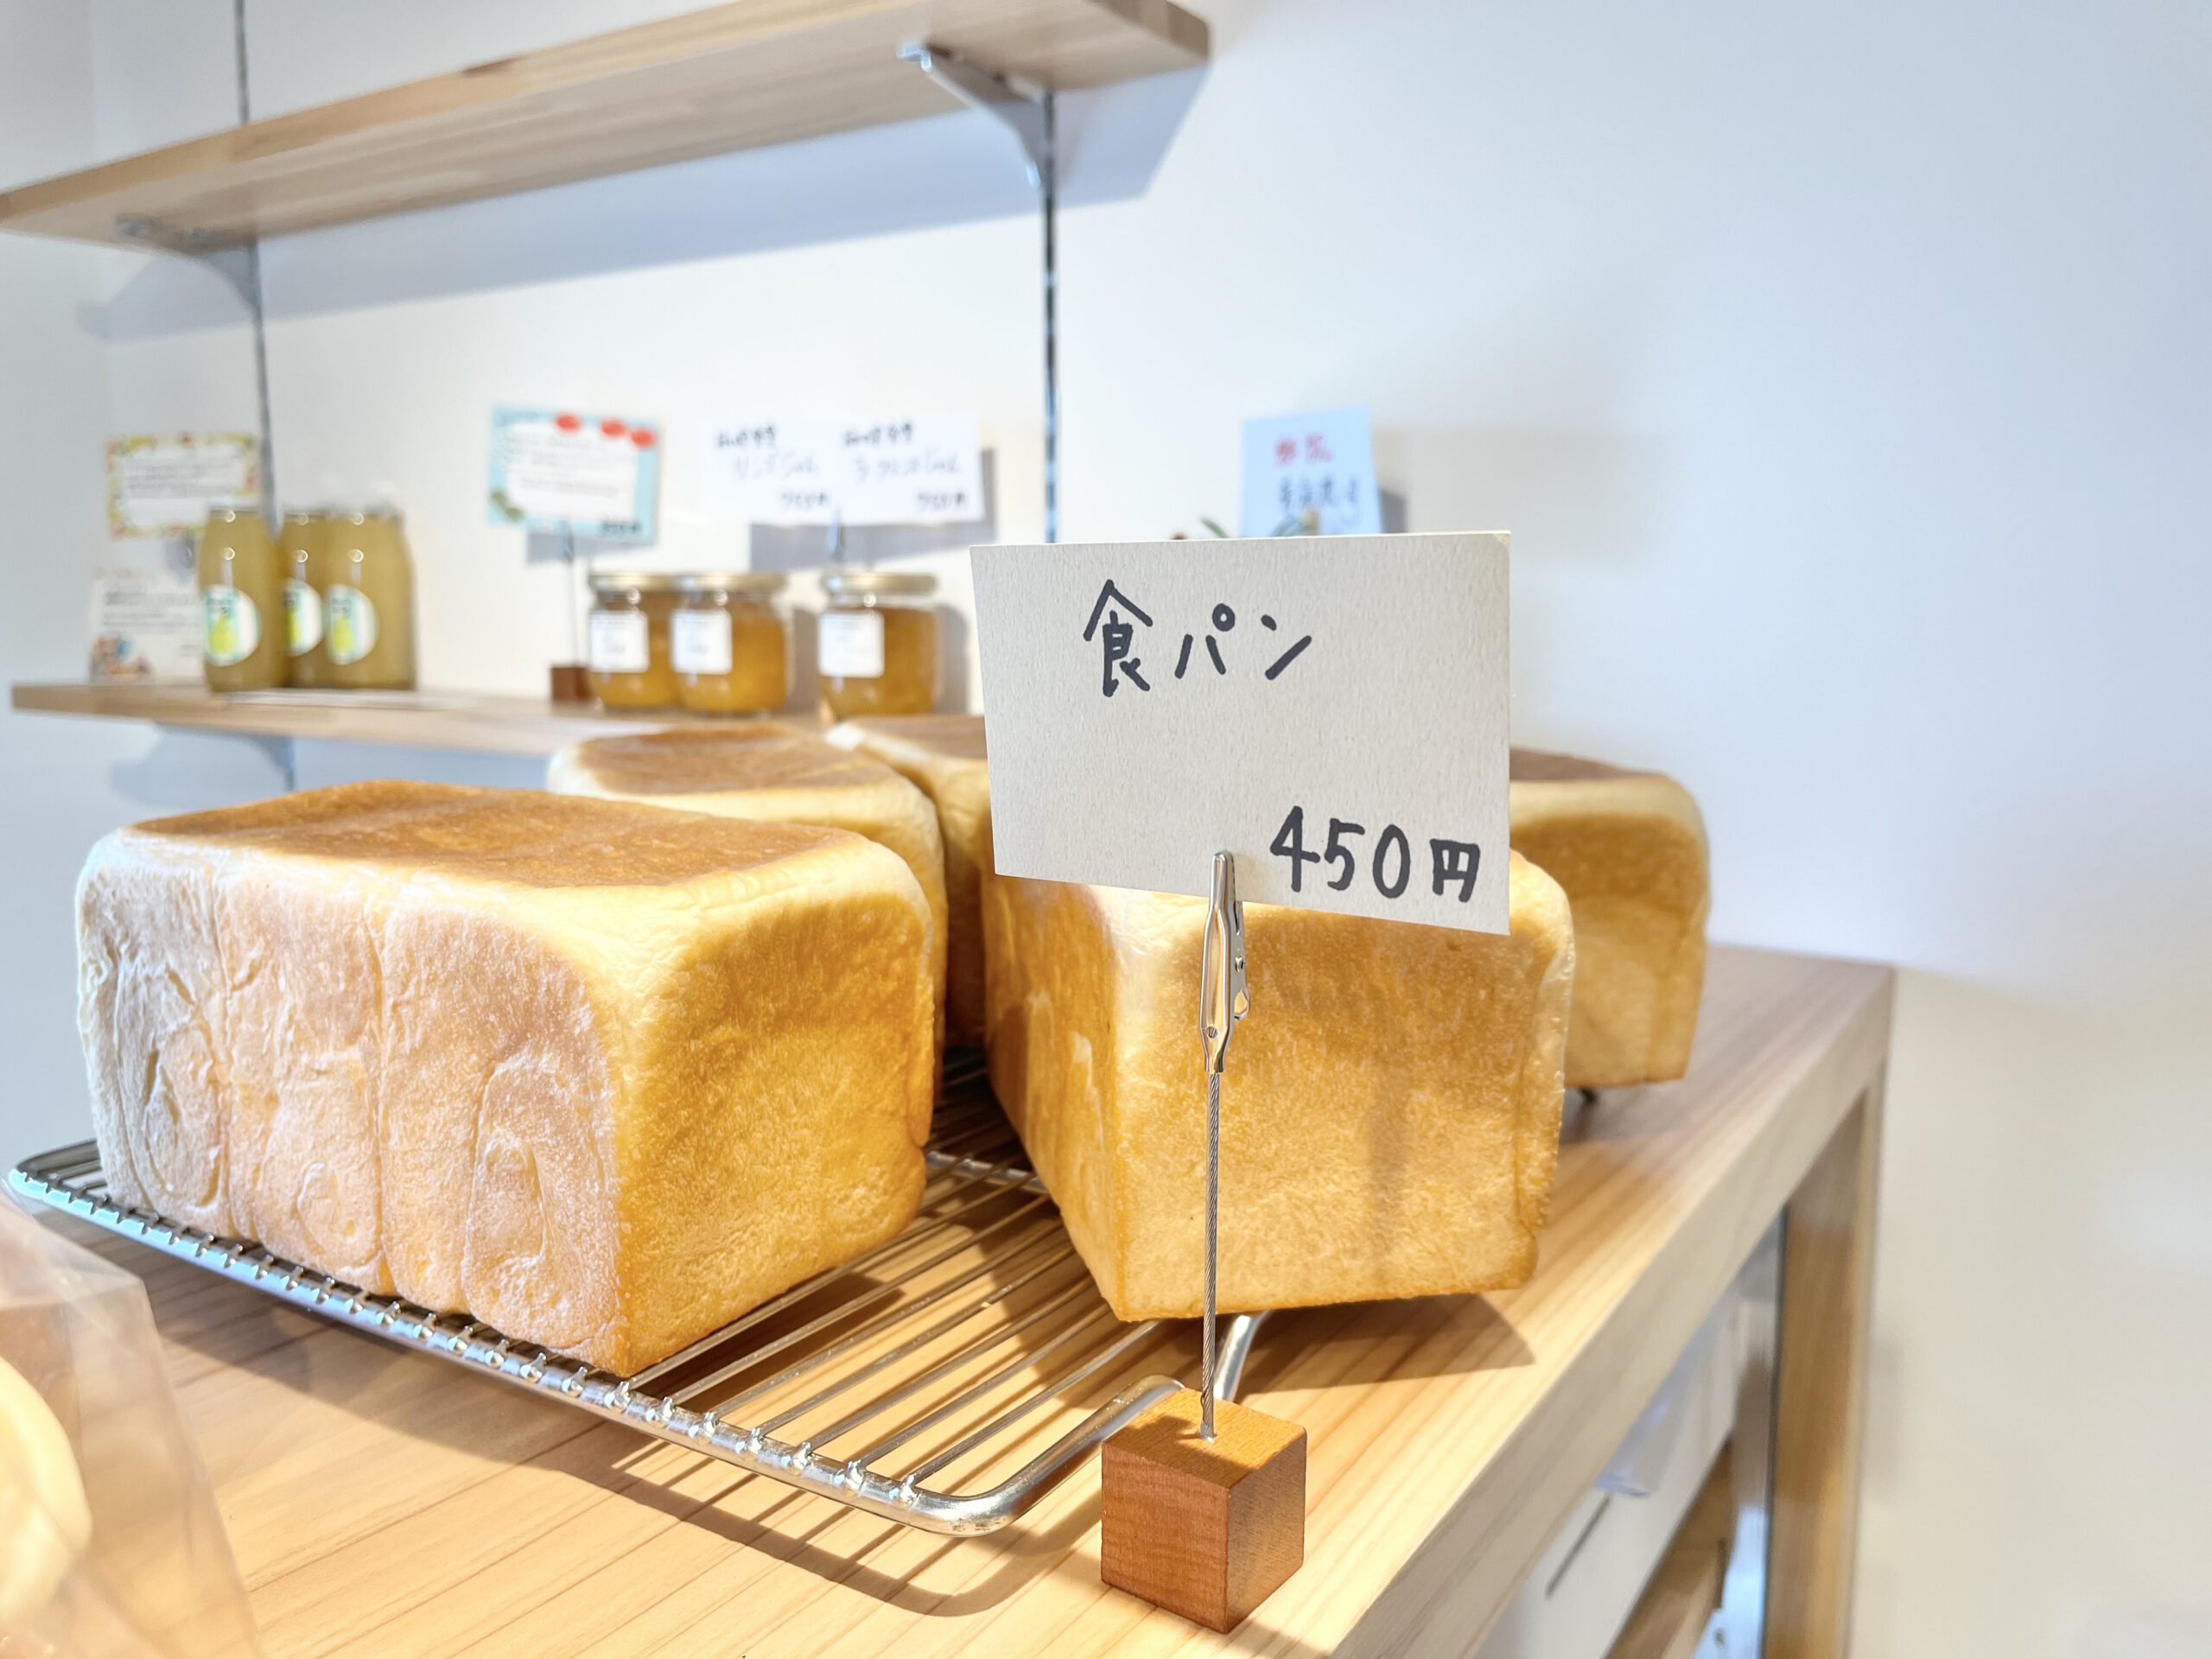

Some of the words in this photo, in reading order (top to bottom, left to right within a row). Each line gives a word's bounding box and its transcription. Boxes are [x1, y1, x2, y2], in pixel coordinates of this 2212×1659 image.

[1083, 579, 1313, 697] 食パン
[1269, 805, 1481, 903] 450円
